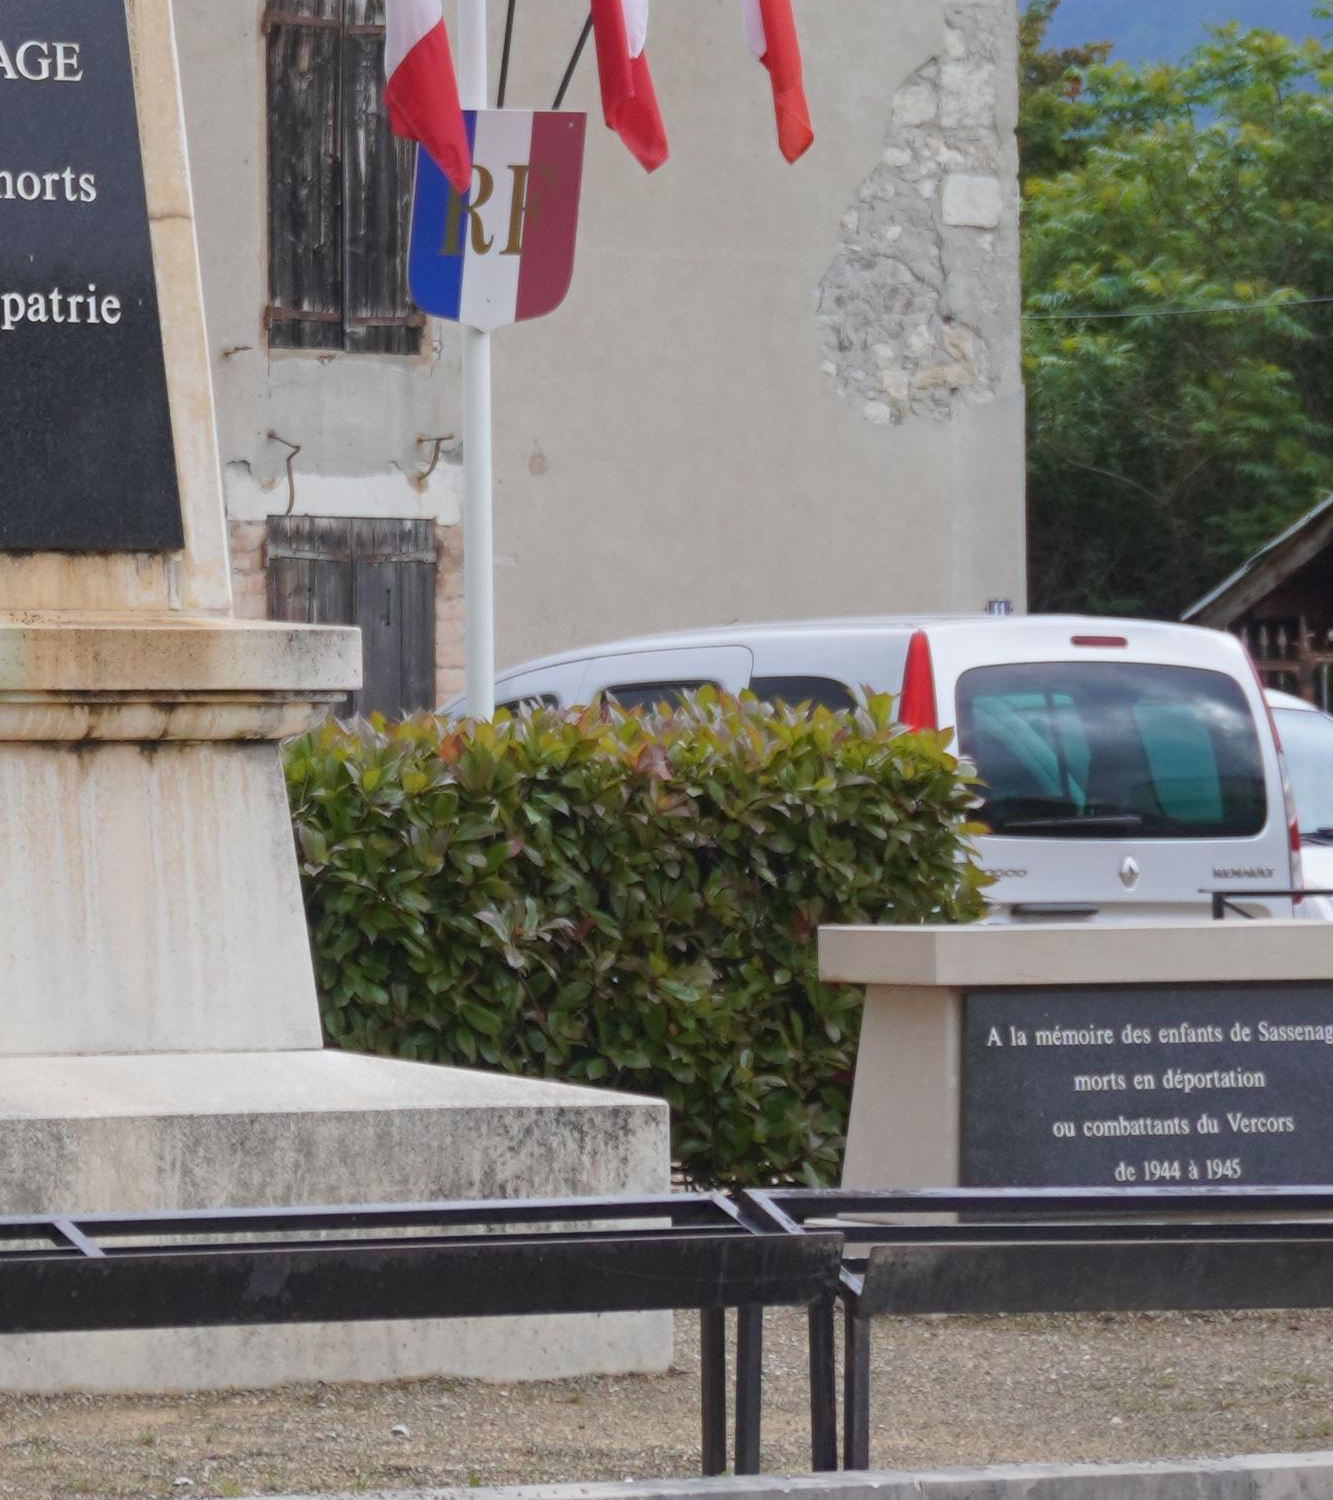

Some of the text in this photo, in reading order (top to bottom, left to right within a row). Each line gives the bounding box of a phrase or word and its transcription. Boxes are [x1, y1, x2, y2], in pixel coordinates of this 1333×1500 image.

[437, 164, 556, 256] RF
[0, 284, 122, 331] patrie
[1212, 867, 1276, 879] RENAULT
[986, 1021, 1333, 1047] A la mémoire des enfants de Sassenag
[1074, 1068, 1266, 1094] morts en déportation
[1052, 1112, 1295, 1138] ou combattants du Vercors
[1115, 1157, 1242, 1183] de 1944 à 1945
